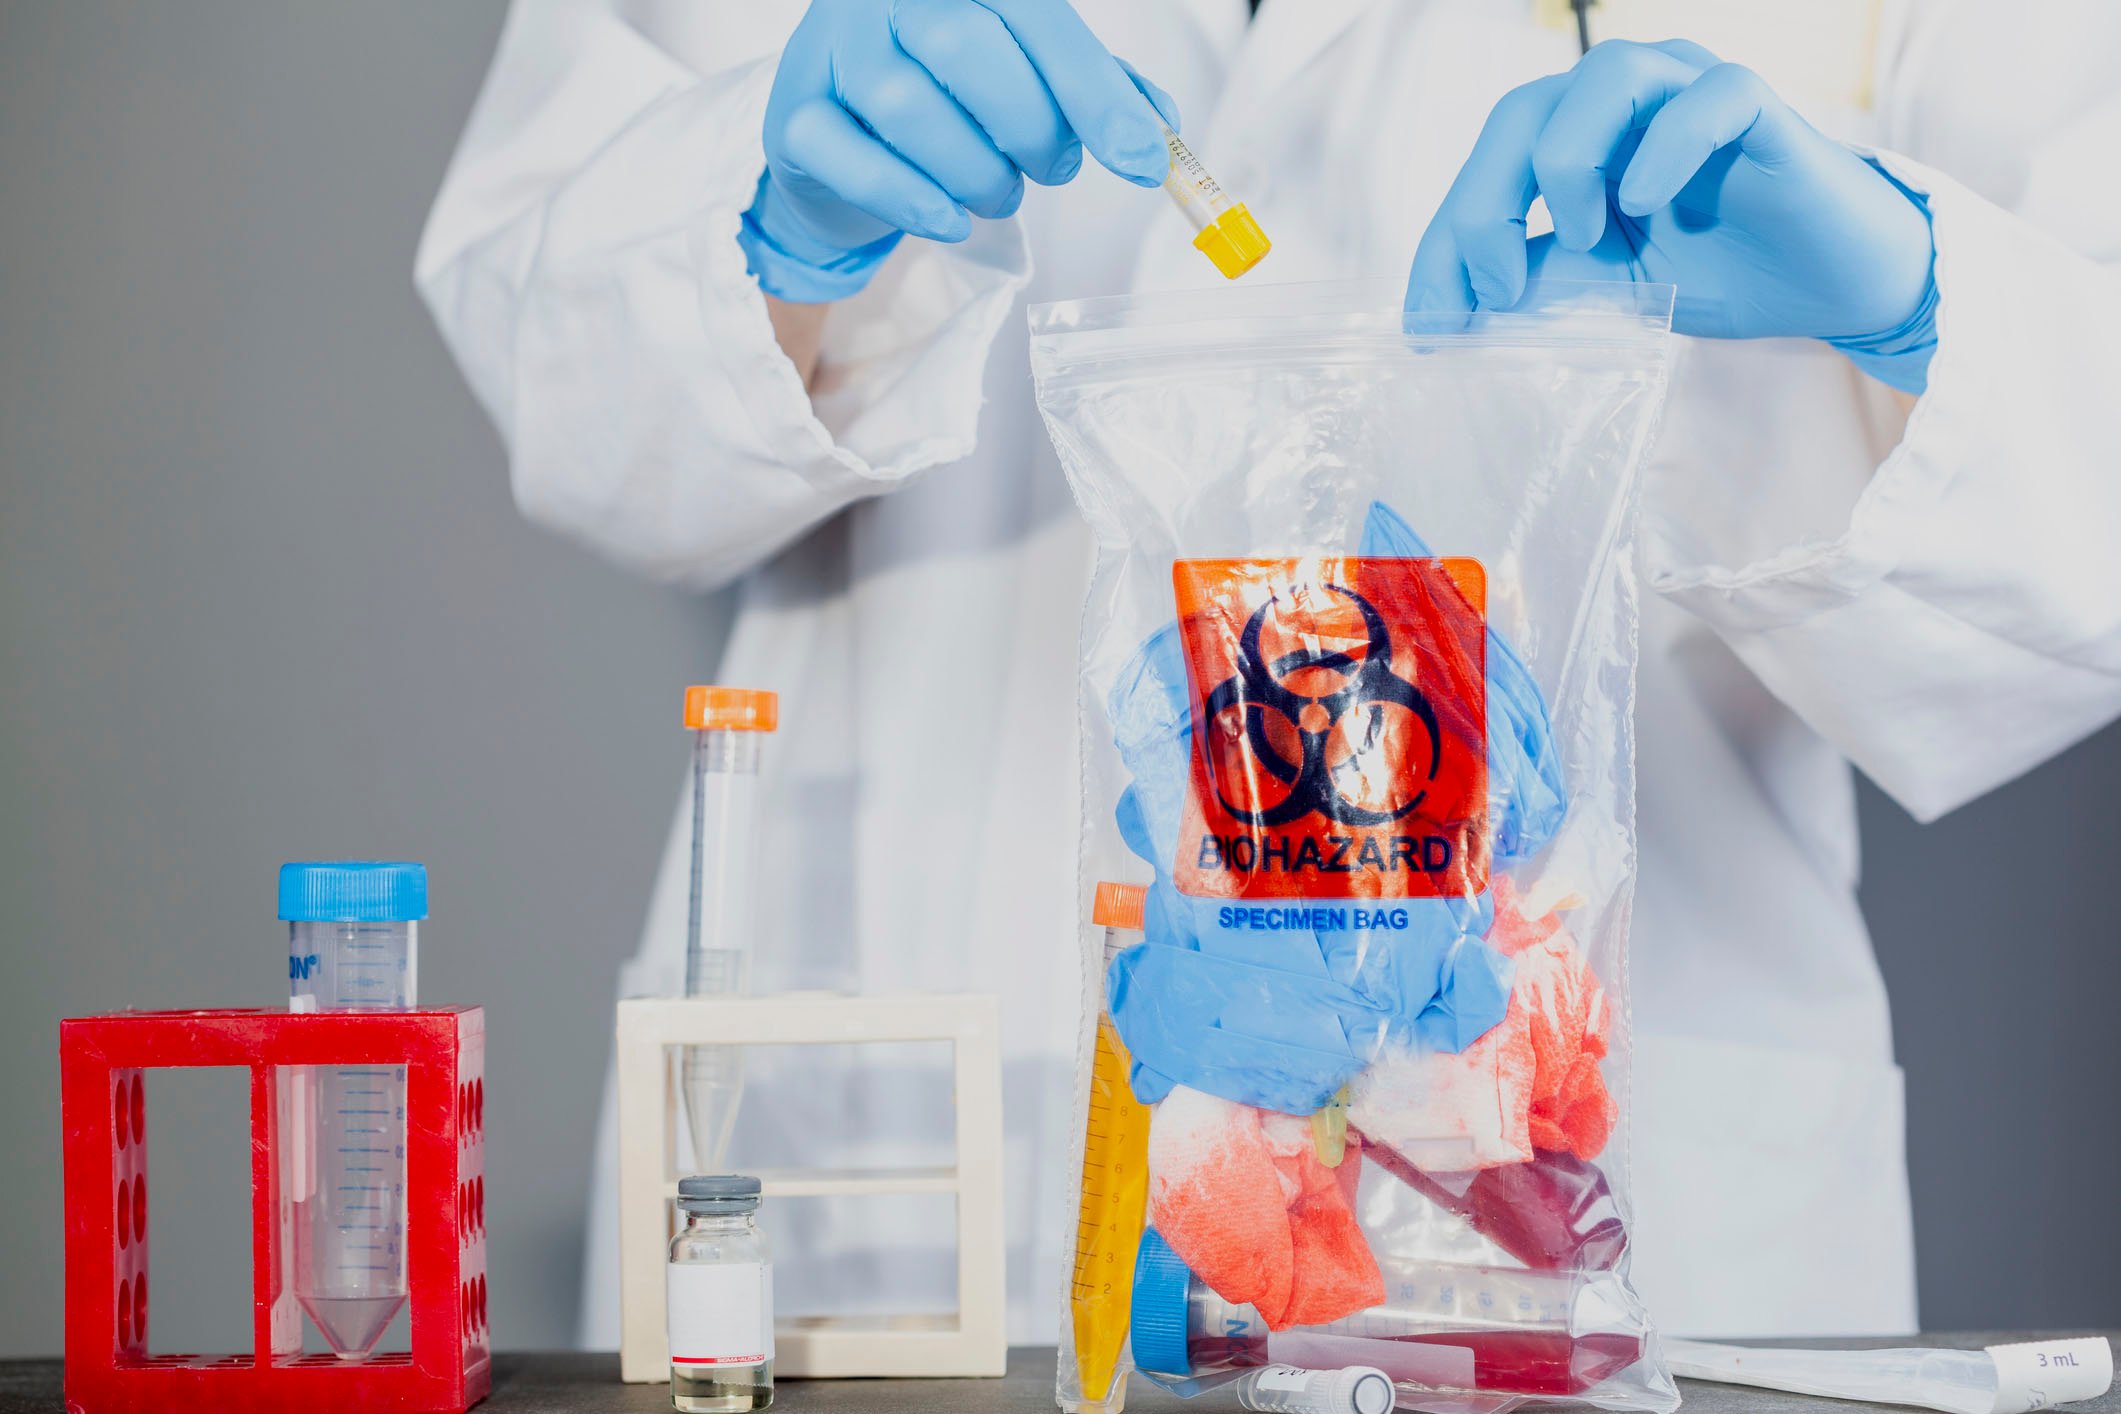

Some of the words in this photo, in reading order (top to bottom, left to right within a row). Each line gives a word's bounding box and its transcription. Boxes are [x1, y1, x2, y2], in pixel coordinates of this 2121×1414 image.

[1198, 180, 1216, 197] LOT
[1198, 834, 1453, 873] BIOHAZARD
[1219, 906, 1345, 930] SPECIMEN
[1354, 908, 1409, 930] BAG
[1120, 1106, 1128, 1117] 8
[1117, 1134, 1126, 1145] 7
[1114, 1163, 1122, 1174] 6
[1112, 1192, 1120, 1204] 5
[1109, 1223, 1117, 1233] 4
[1106, 1252, 1114, 1263] 3
[1103, 1283, 1112, 1294] 2
[2037, 1353, 2048, 1367] 3
[2053, 1352, 2079, 1368] mL
